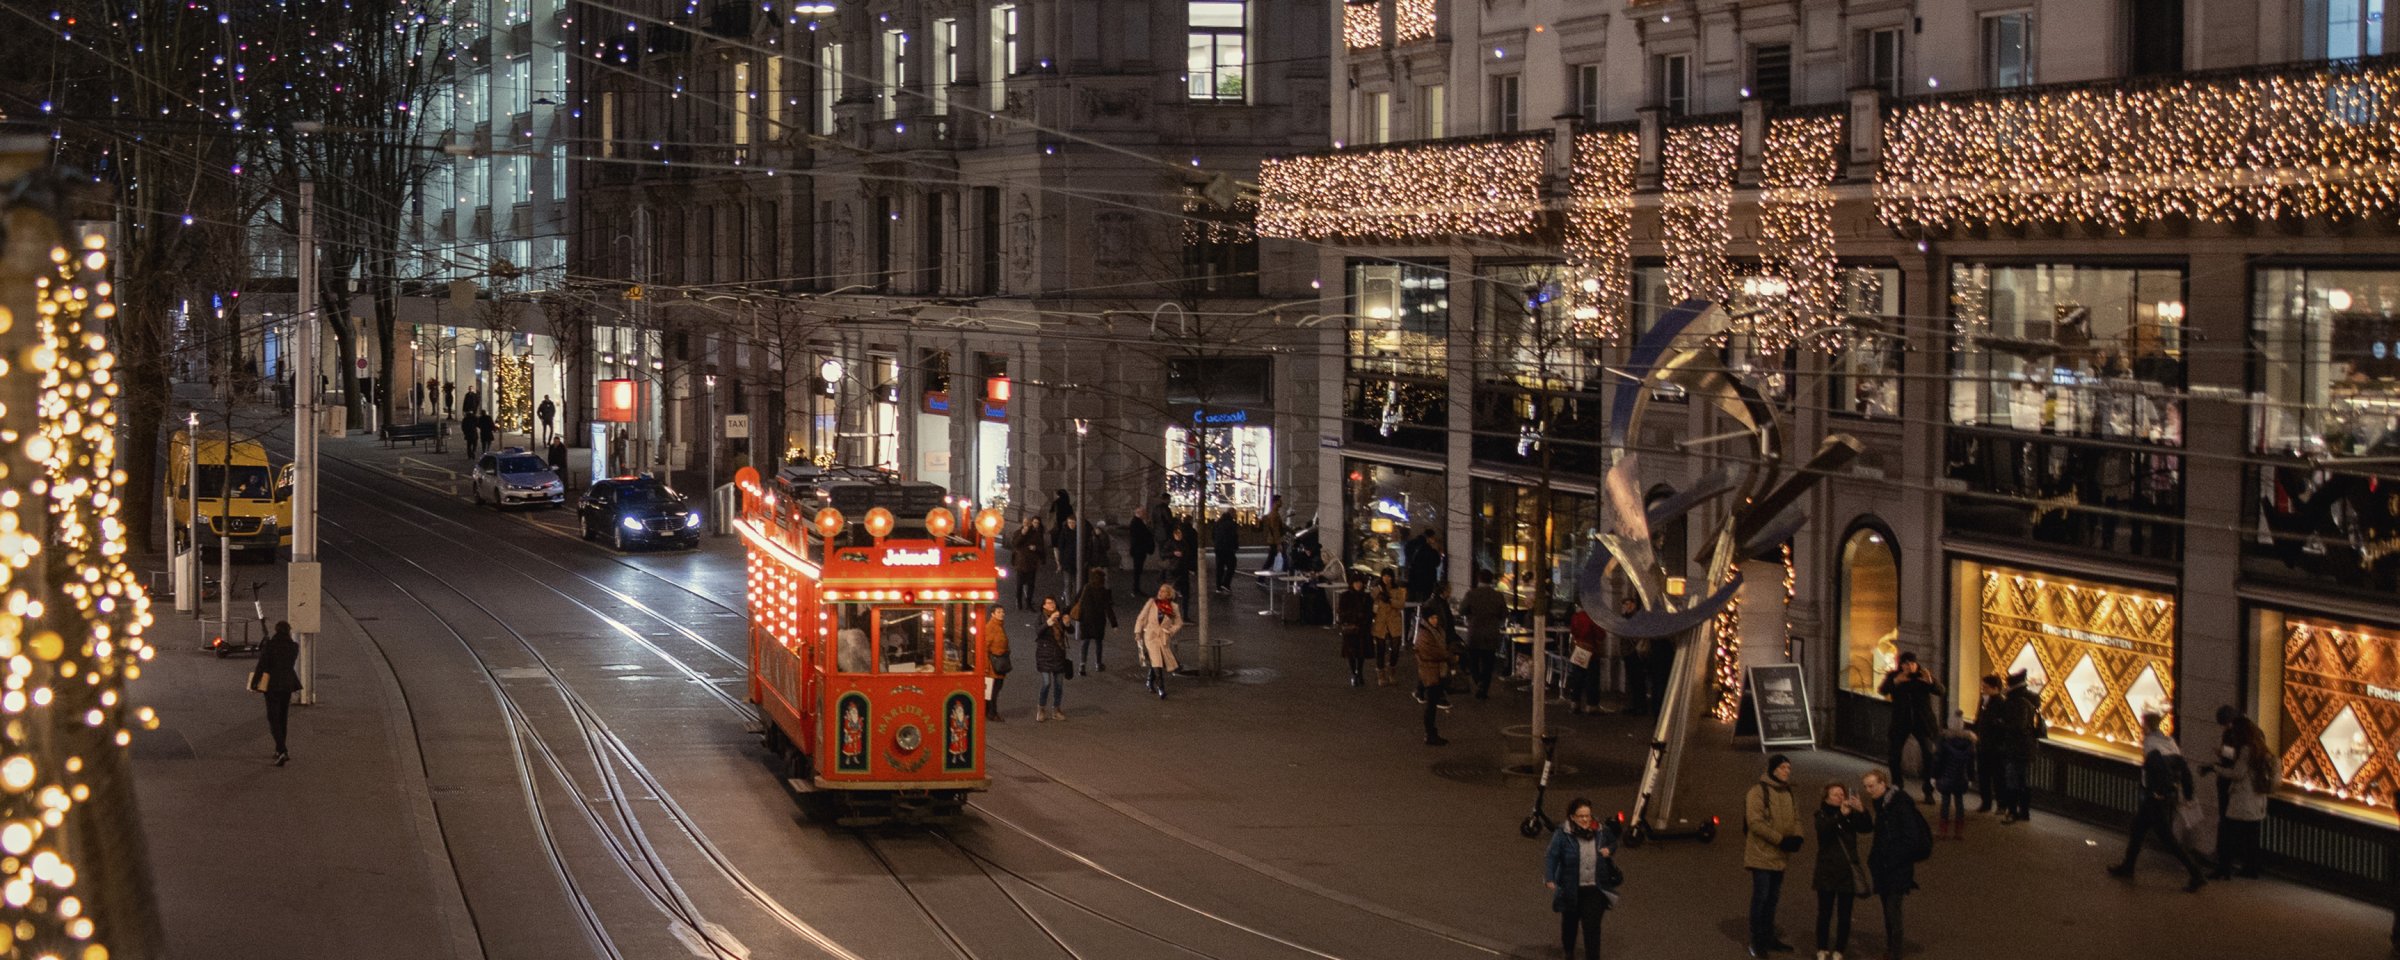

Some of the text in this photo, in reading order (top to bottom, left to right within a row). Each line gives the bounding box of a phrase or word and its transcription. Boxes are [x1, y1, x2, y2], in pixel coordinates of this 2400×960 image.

[728, 420, 747, 428] TAXI
[882, 548, 941, 566] Jelmoli
[2042, 623, 2133, 649] FROHE WEIHNACHTEN
